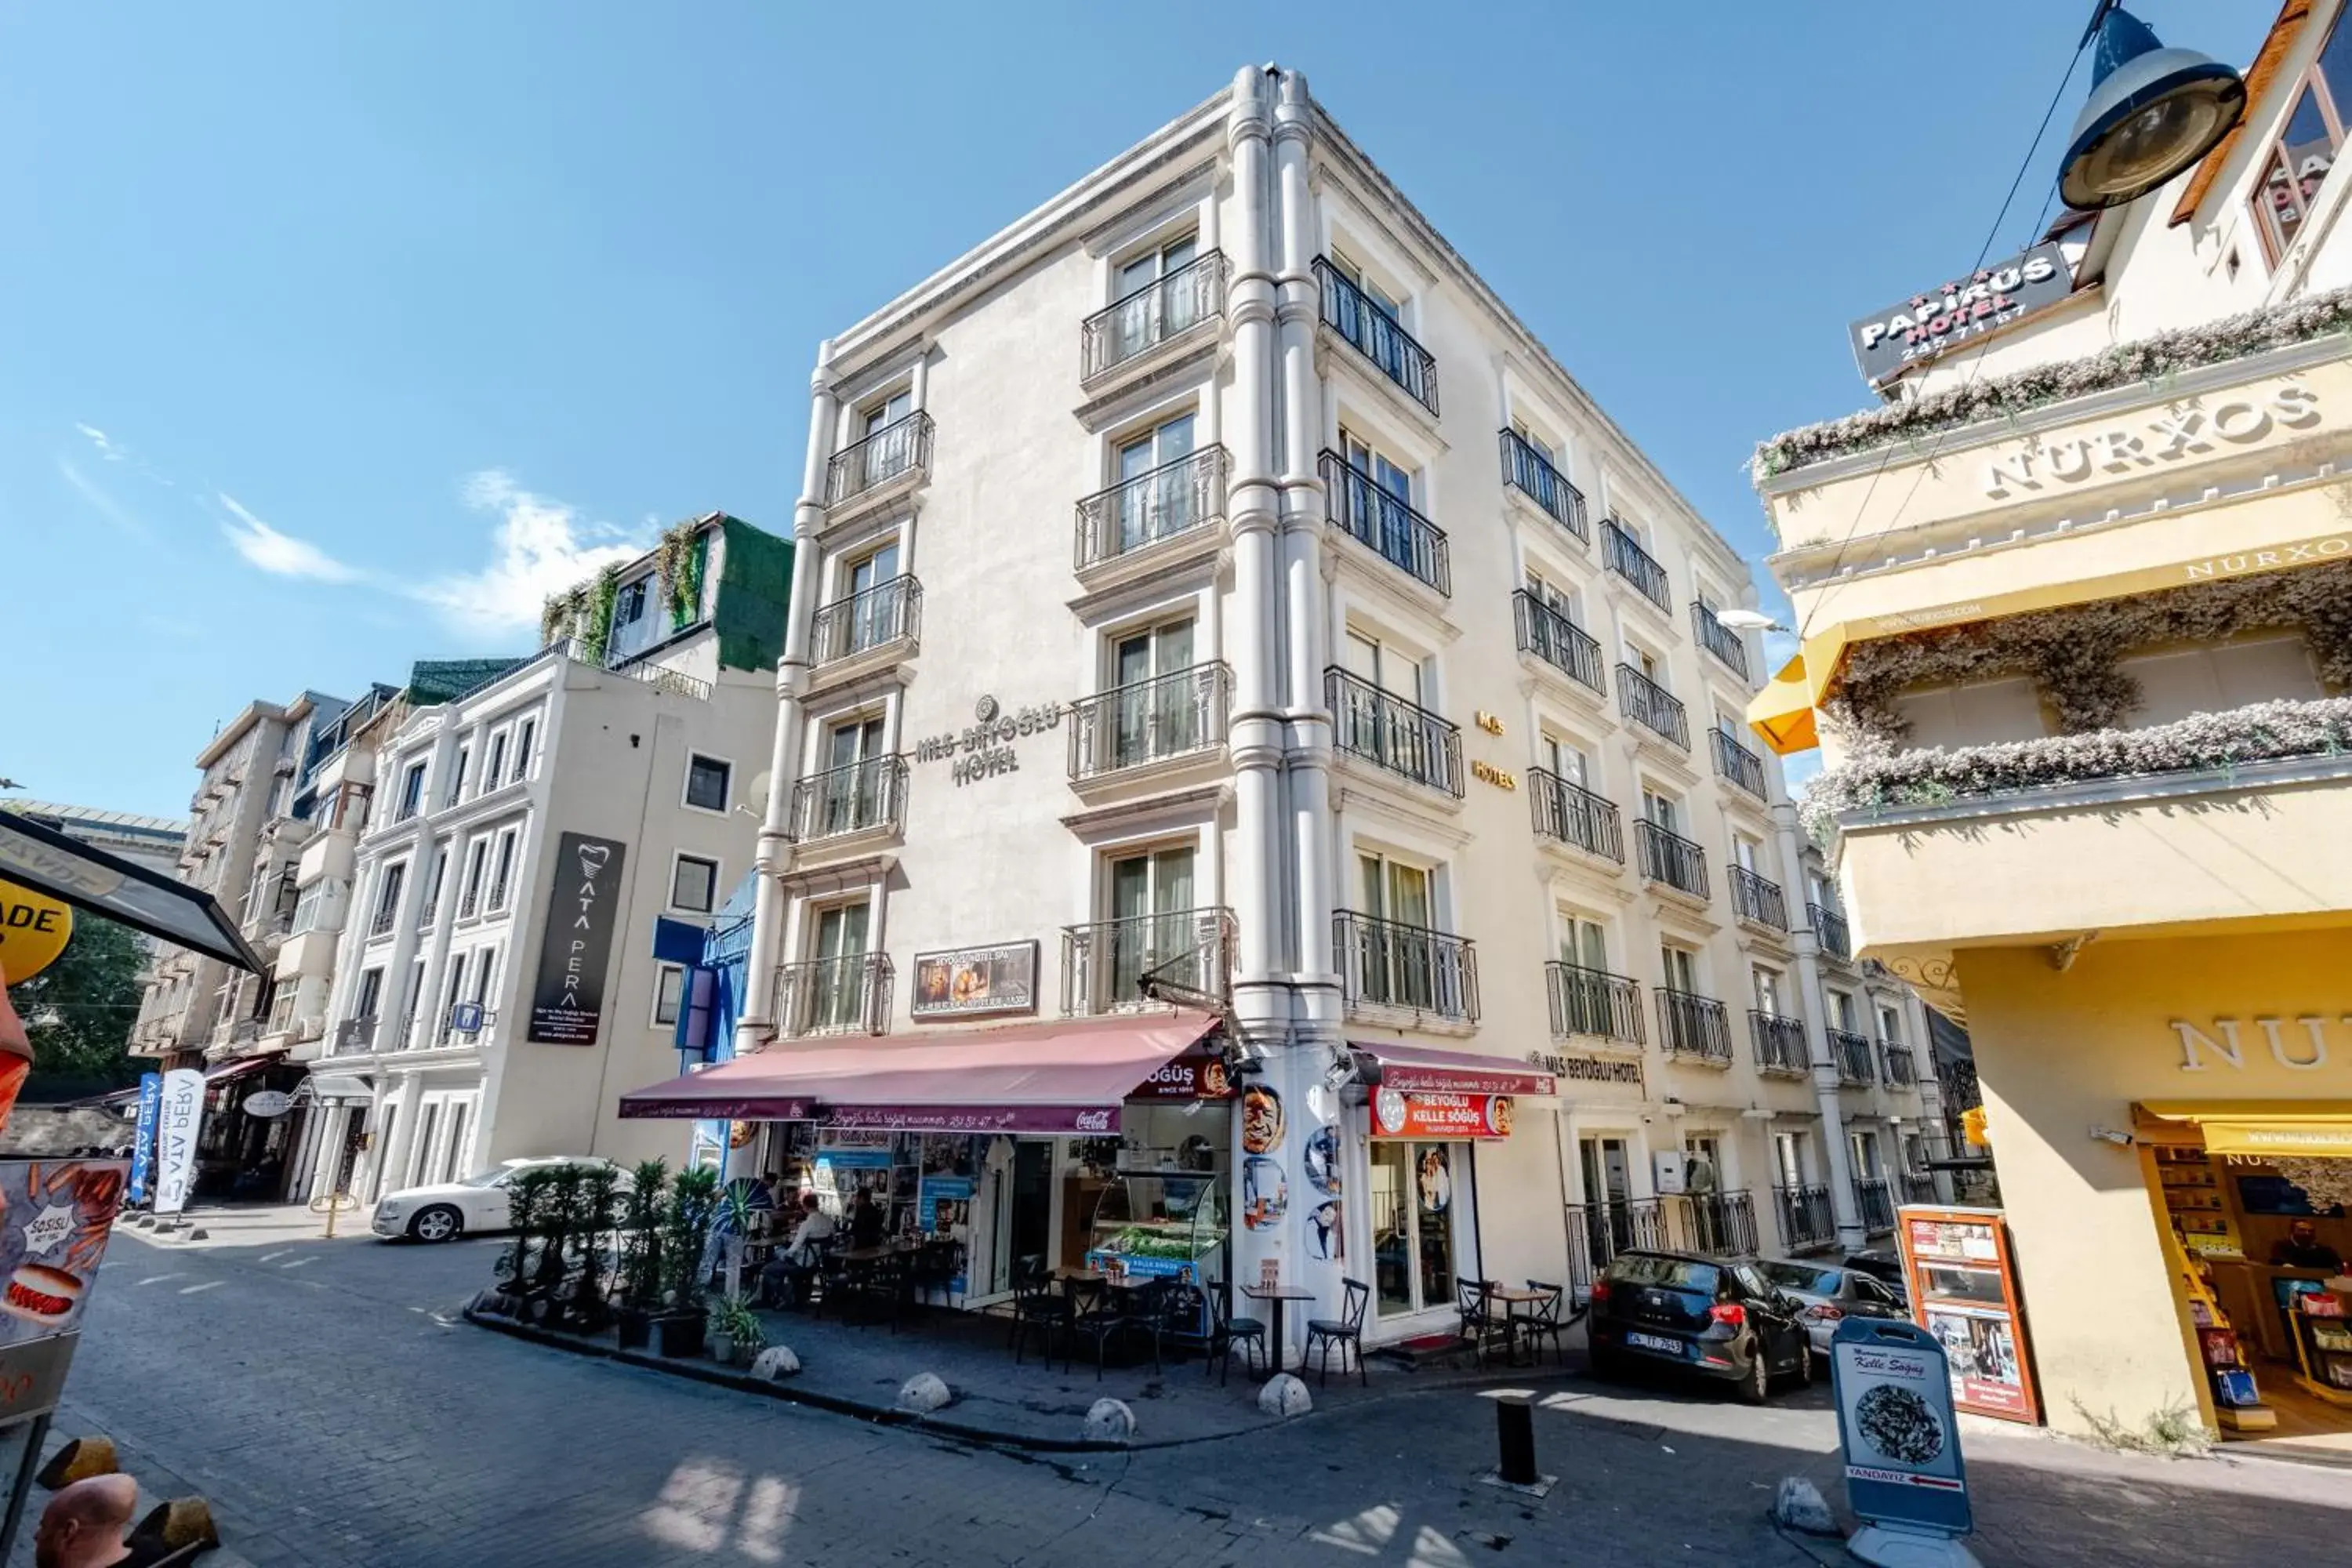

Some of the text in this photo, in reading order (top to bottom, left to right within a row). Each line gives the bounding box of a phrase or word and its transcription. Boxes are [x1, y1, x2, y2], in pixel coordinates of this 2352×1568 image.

[1905, 295, 2016, 345] HOTEL
[1982, 386, 2321, 499] NURXOS
[2186, 538, 2350, 579] NURXO
[953, 746, 1019, 787] HOTEL
[0, 903, 62, 933] DE
[2169, 1016, 2352, 1072] NU
[1613, 1062, 1641, 1083] HOTEL
[1413, 1109, 1446, 1123] KELLE
